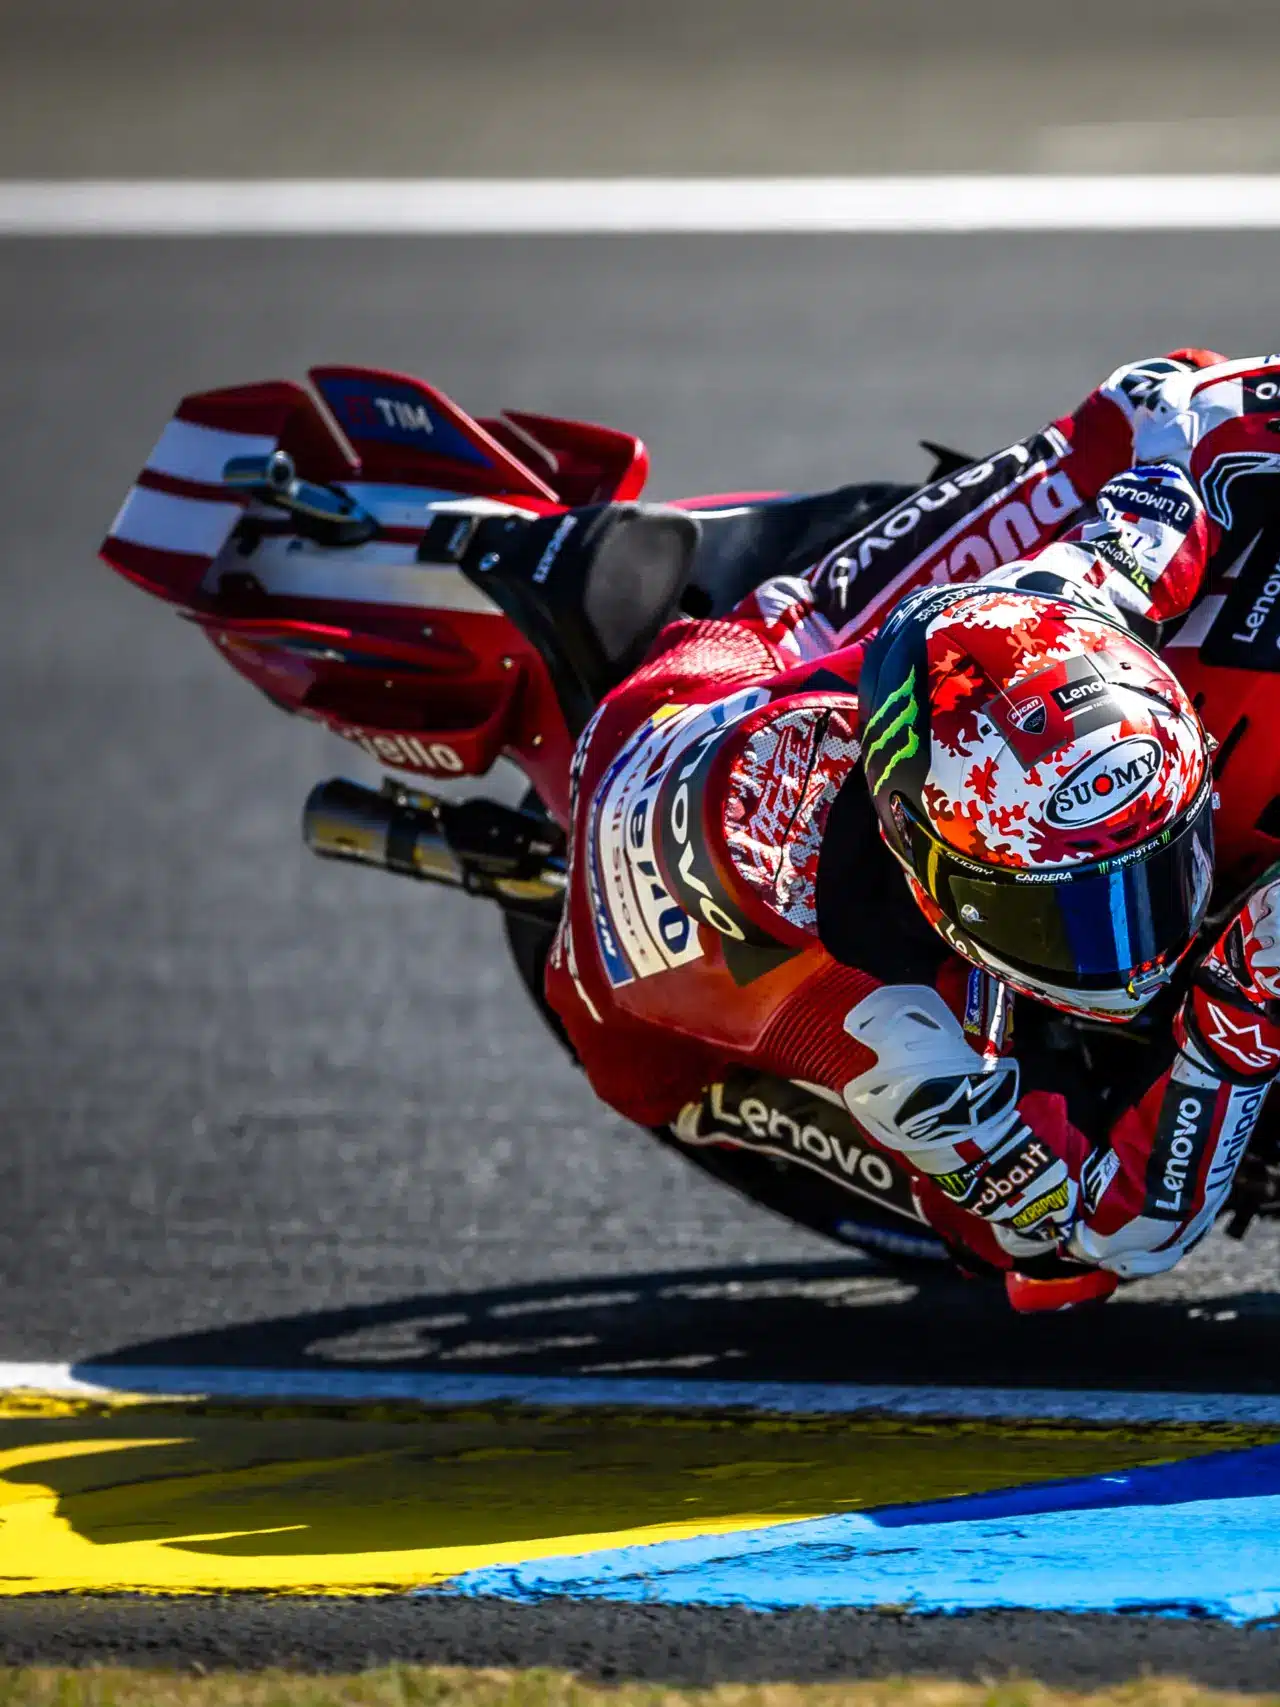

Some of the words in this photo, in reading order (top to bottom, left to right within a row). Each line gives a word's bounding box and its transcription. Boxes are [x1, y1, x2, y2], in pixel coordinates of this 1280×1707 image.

[828, 445, 1029, 590] Lenovo
[1100, 484, 1176, 513] LIMOLAN
[1011, 700, 1039, 719] DUCATI
[1059, 681, 1104, 703] Leno
[1056, 752, 1156, 812] SUOMY
[1015, 872, 1073, 882] CARRERA
[1112, 839, 1160, 867] MONSTER
[710, 1083, 893, 1190] Lenovo
[1156, 1098, 1202, 1212] Lenovo
[1206, 1084, 1266, 1192] Unipol
[967, 1143, 1049, 1215] ruba.it
